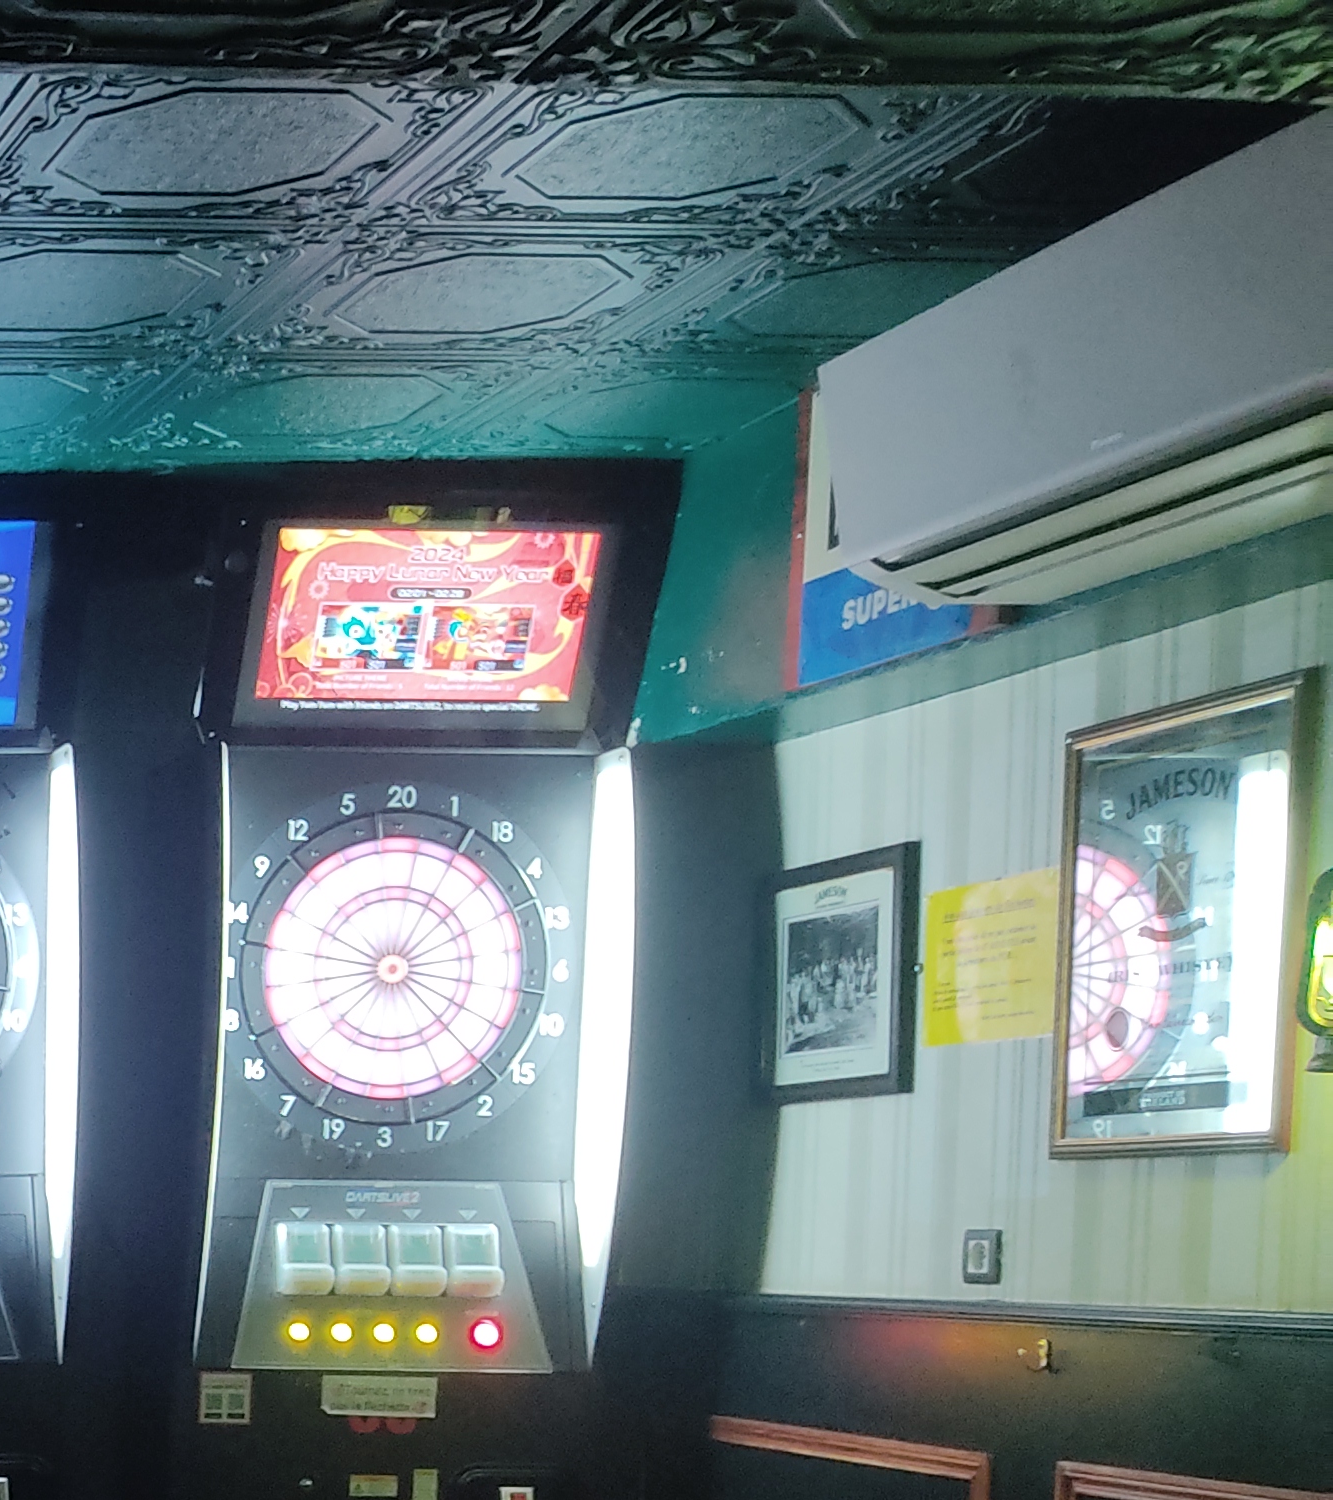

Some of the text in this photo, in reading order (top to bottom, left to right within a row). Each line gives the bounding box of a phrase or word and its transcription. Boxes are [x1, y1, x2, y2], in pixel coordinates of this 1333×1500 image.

[408, 547, 467, 563] 2024
[317, 562, 551, 584] Happy Lunar New Year
[340, 793, 356, 816] 5
[387, 786, 418, 809] 20
[1126, 767, 1238, 821] JAMESON
[450, 797, 460, 817] 1
[288, 819, 309, 841] 12
[492, 821, 514, 842] 18
[254, 856, 270, 878] 9
[526, 857, 543, 879] 4
[545, 906, 570, 930] 13
[552, 959, 569, 983] 6
[539, 1013, 564, 1037] 10
[243, 1058, 266, 1080] 16
[512, 1062, 535, 1084] 15
[280, 1095, 297, 1117] 7
[476, 1095, 493, 1117] 2
[322, 1119, 345, 1140] 19
[377, 1127, 393, 1148] 3
[426, 1120, 451, 1142] 17
[345, 1190, 421, 1204] DARTSLIVE2
